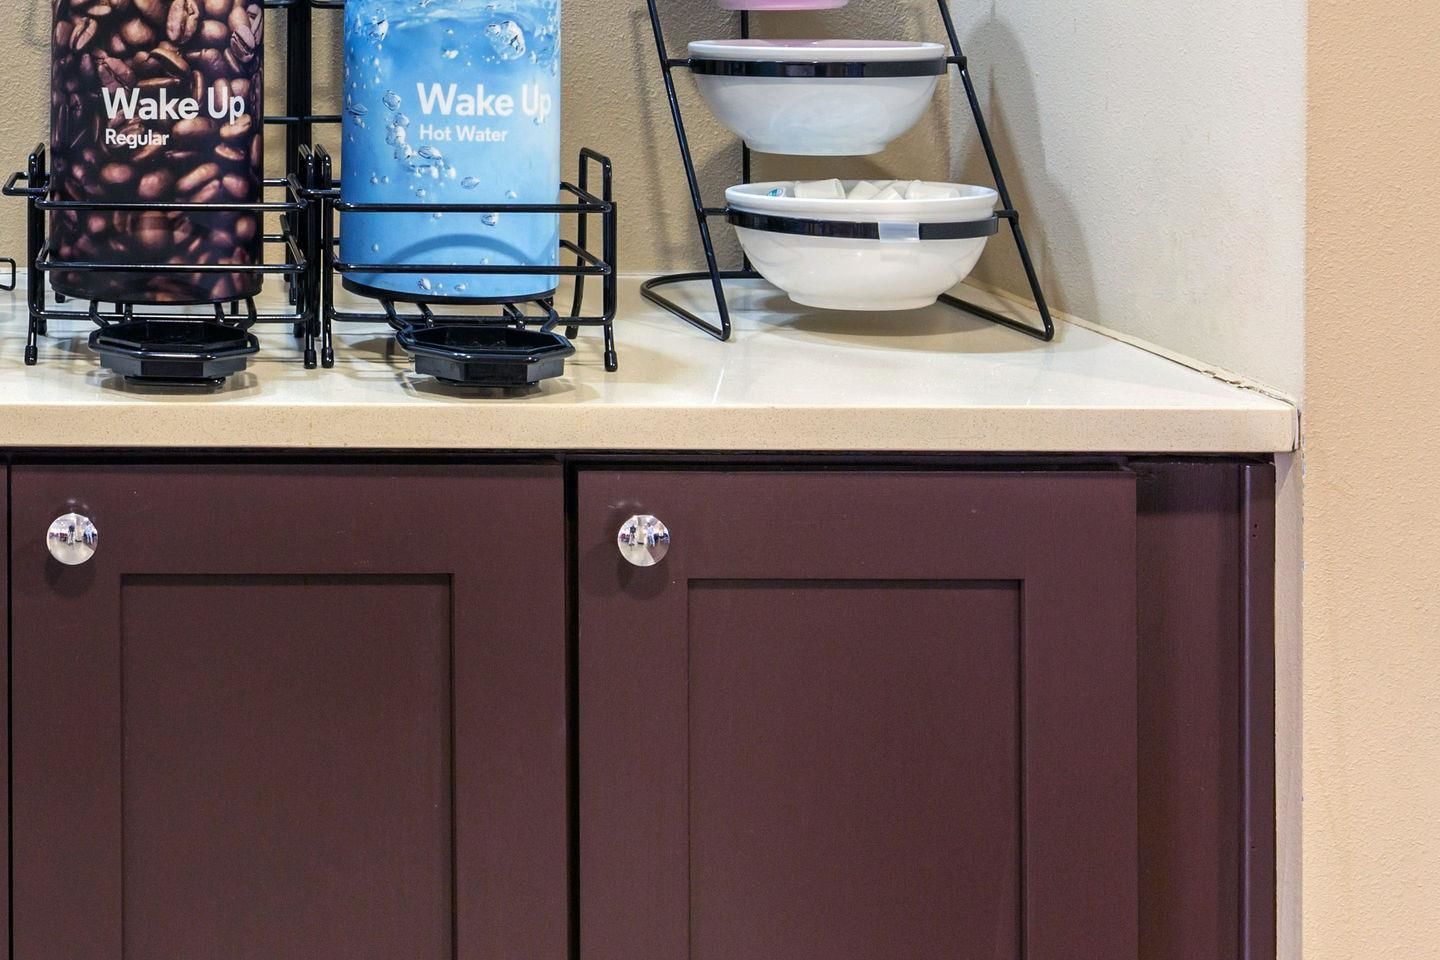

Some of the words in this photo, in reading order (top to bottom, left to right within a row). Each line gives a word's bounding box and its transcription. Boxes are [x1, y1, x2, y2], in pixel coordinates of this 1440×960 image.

[101, 86, 200, 120] Wake
[207, 86, 245, 125] Up
[416, 82, 514, 117] Wake
[521, 83, 552, 124] Up
[105, 128, 170, 149] Regular
[419, 124, 452, 141] Hot
[455, 124, 508, 142] Water
